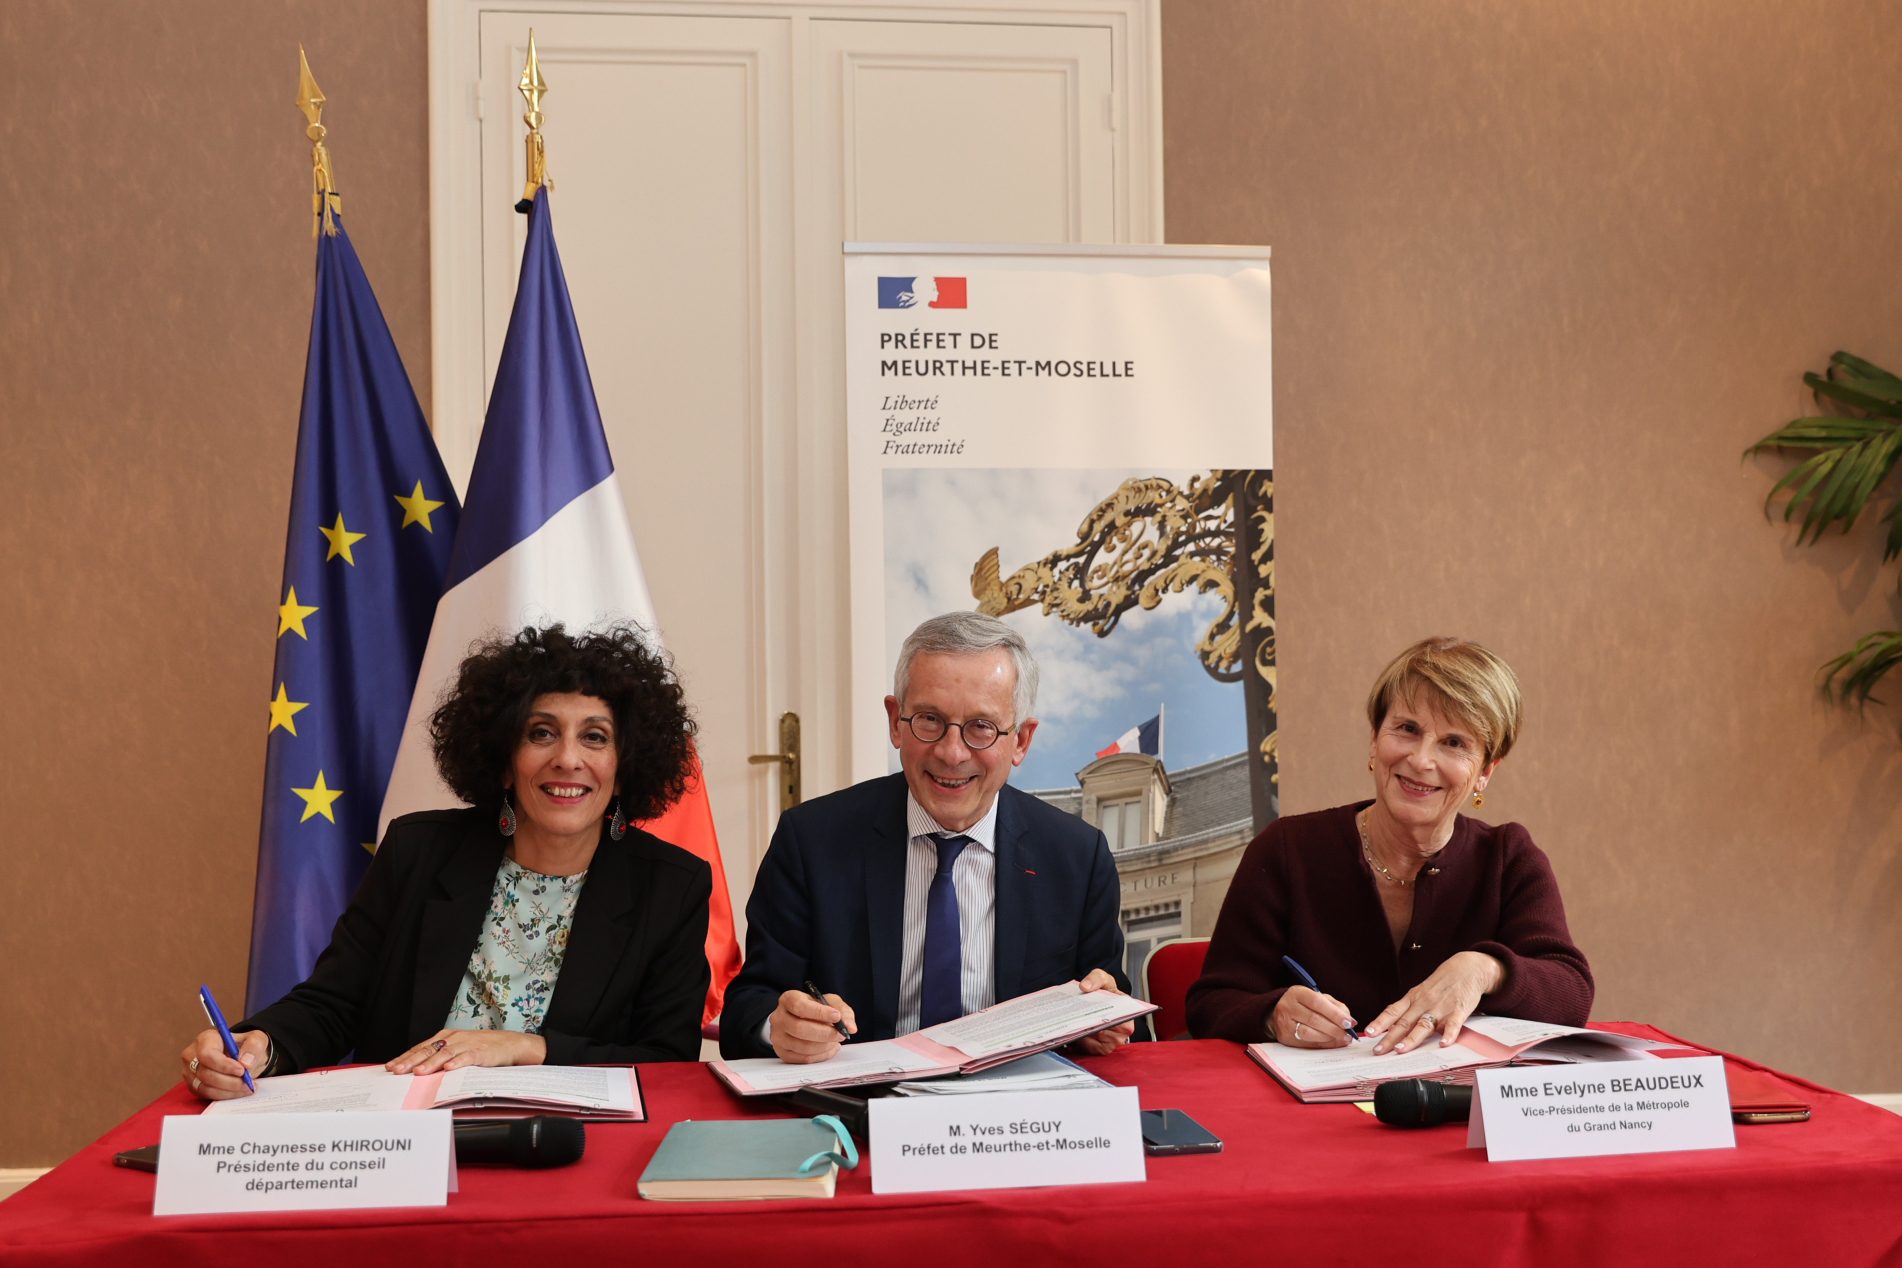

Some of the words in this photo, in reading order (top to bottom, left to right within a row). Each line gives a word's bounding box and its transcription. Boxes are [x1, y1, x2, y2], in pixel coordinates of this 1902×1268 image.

[881, 328, 961, 349] PRÉFET
[971, 333, 998, 349] DE
[881, 360, 1134, 377] MEURTHE-ET-MOSELLE
[881, 395, 938, 410] Liberté
[881, 415, 940, 436] Égalité
[881, 438, 966, 456] Fraternité
[1119, 872, 1179, 893] CTURE
[1500, 1085, 1538, 1098] Mme
[1543, 1082, 1605, 1097] Evelyne
[1611, 1075, 1703, 1092] BEAUDEUX
[1522, 1104, 1605, 1116] Vice-Présidente
[1608, 1103, 1621, 1112] de
[1624, 1103, 1633, 1111] la
[1637, 1099, 1689, 1111] Métropole
[949, 1125, 964, 1136] M.
[970, 1124, 1004, 1135] Yves
[1010, 1119, 1061, 1134] SÉGUY
[1567, 1123, 1580, 1132] du
[1584, 1121, 1616, 1131] Grand
[1620, 1121, 1652, 1130] Nancy
[199, 1143, 235, 1155] Mme
[241, 1142, 326, 1156] Chaynesse
[332, 1139, 411, 1152] KHIROUNI
[902, 1144, 945, 1156] Préfet
[950, 1143, 966, 1154] de
[972, 1137, 1110, 1153] Meurthe-et-Moselle
[217, 1160, 299, 1173] Présidente
[305, 1159, 324, 1171] du
[330, 1158, 385, 1170] conseil
[246, 1176, 357, 1193] départemental
